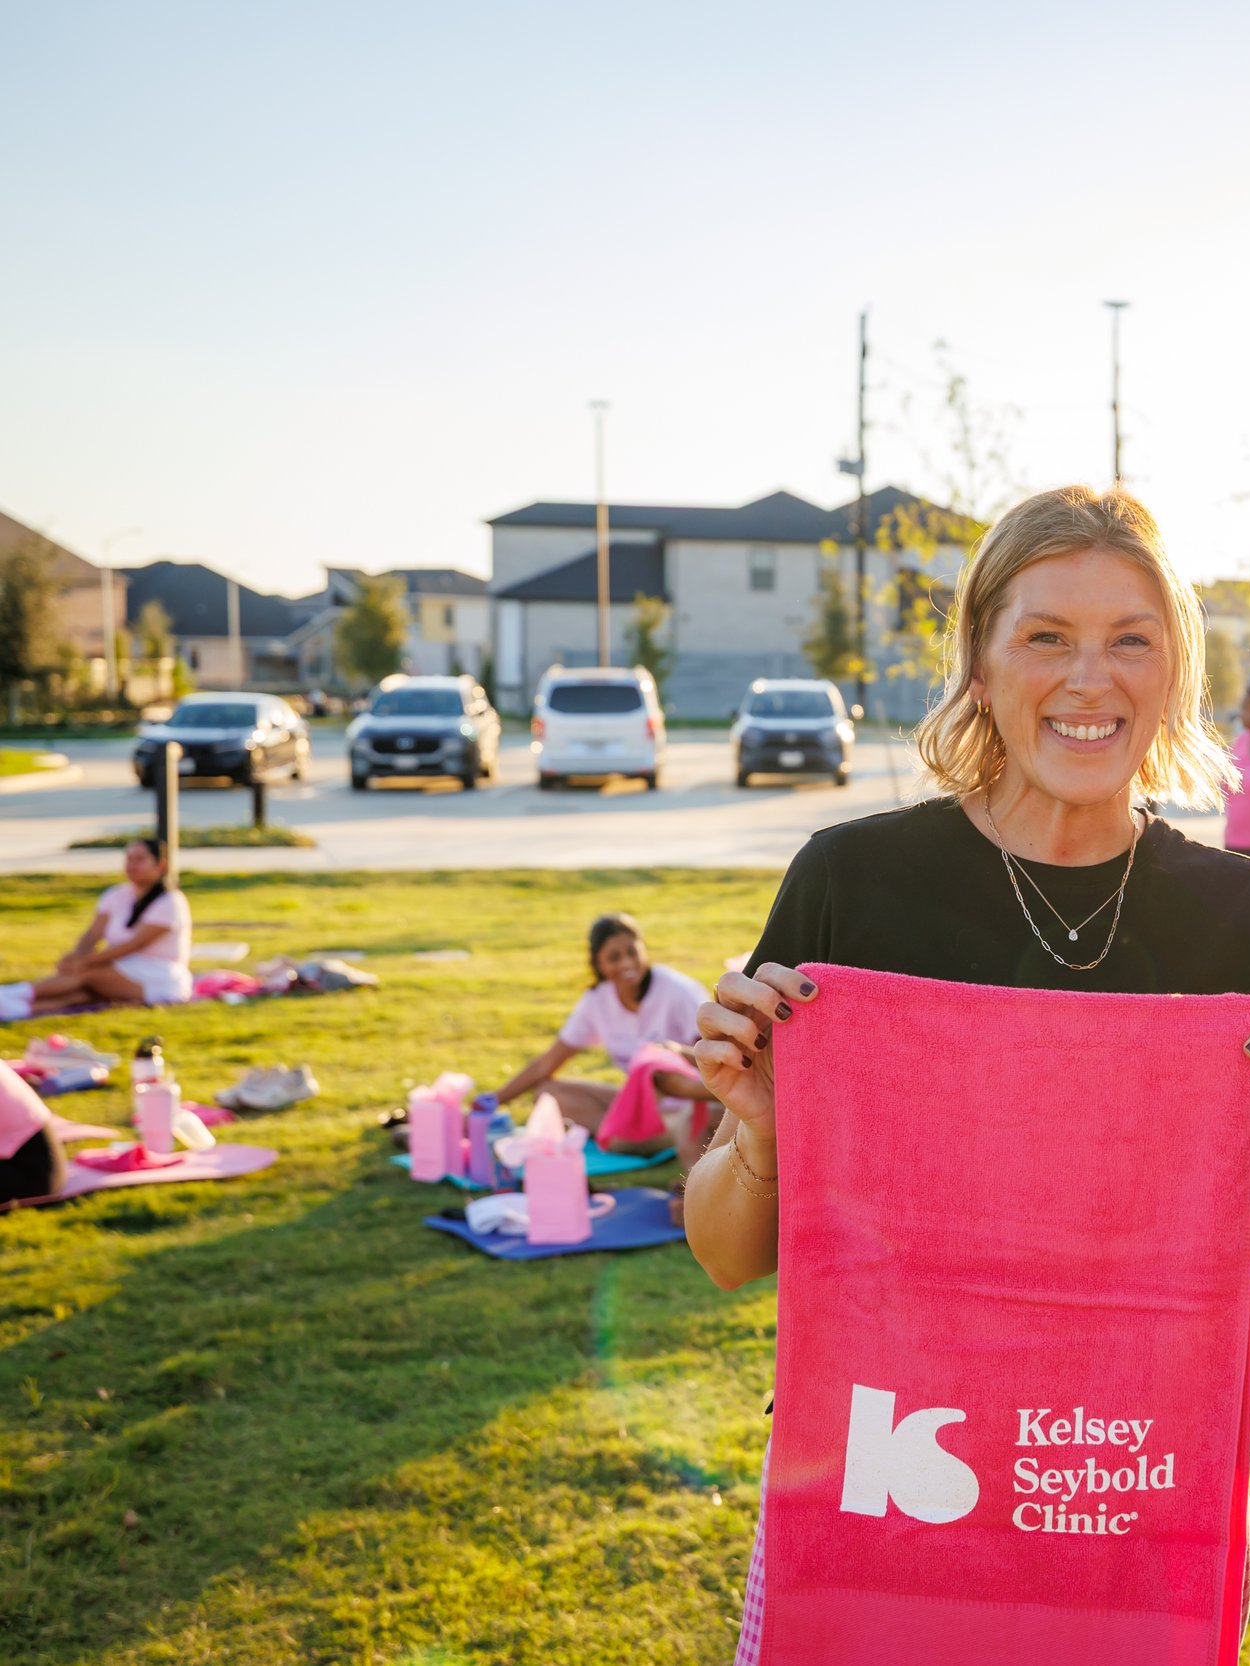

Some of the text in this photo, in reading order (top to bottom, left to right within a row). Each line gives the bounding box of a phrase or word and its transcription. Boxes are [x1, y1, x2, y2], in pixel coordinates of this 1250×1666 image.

[1014, 1406, 1155, 1454] Kelsey
[1012, 1452, 1176, 1502] Seybold
[1012, 1501, 1138, 1536] Clinic
